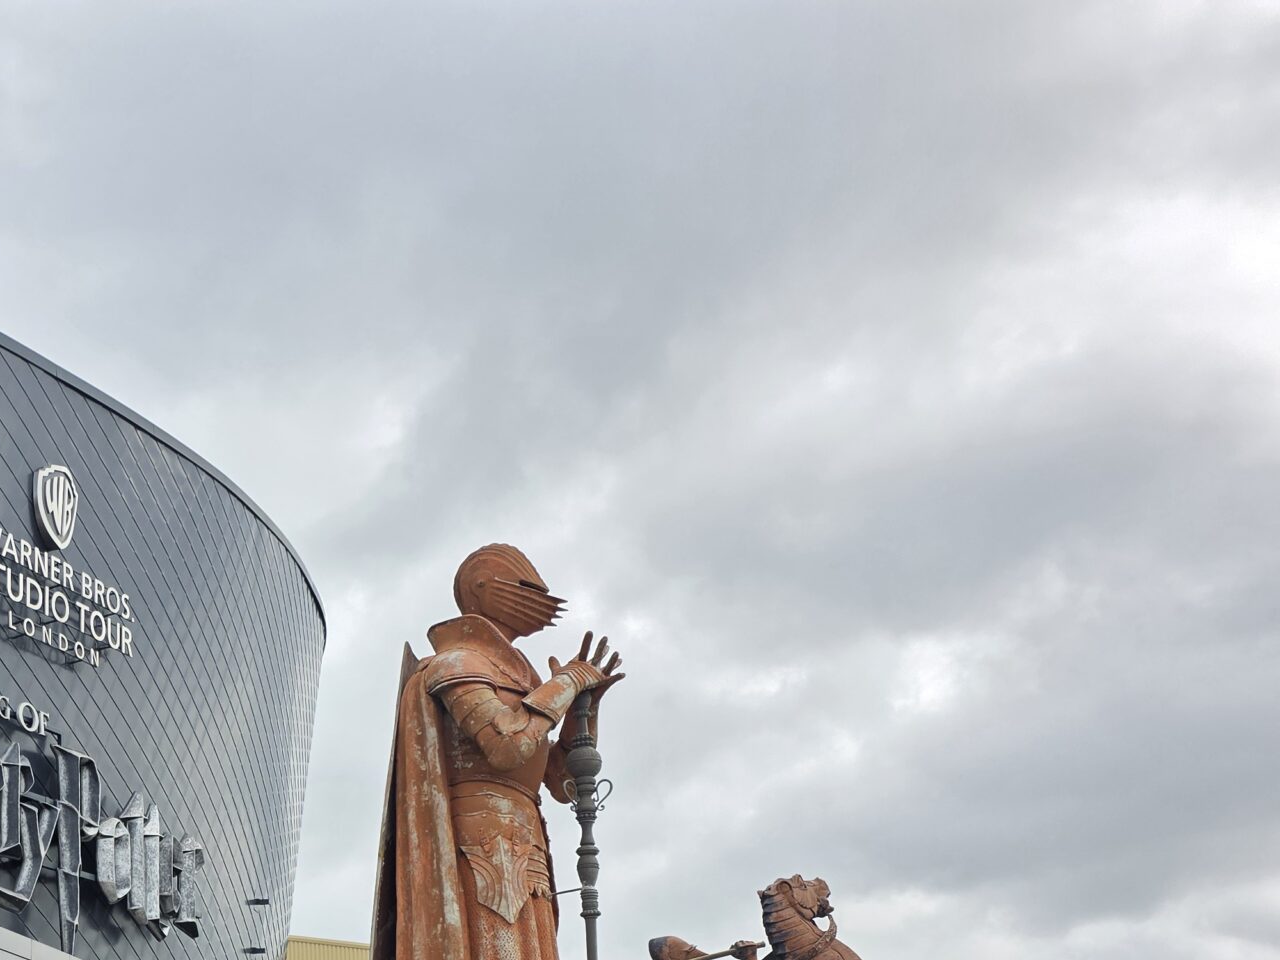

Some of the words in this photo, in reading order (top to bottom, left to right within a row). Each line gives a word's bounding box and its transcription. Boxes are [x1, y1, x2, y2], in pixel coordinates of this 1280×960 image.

[81, 572, 135, 623] BROS.
[8, 610, 100, 668] LONDON
[76, 601, 133, 658] TOUR
[17, 702, 50, 736] OF
[50, 743, 205, 954] Potter
